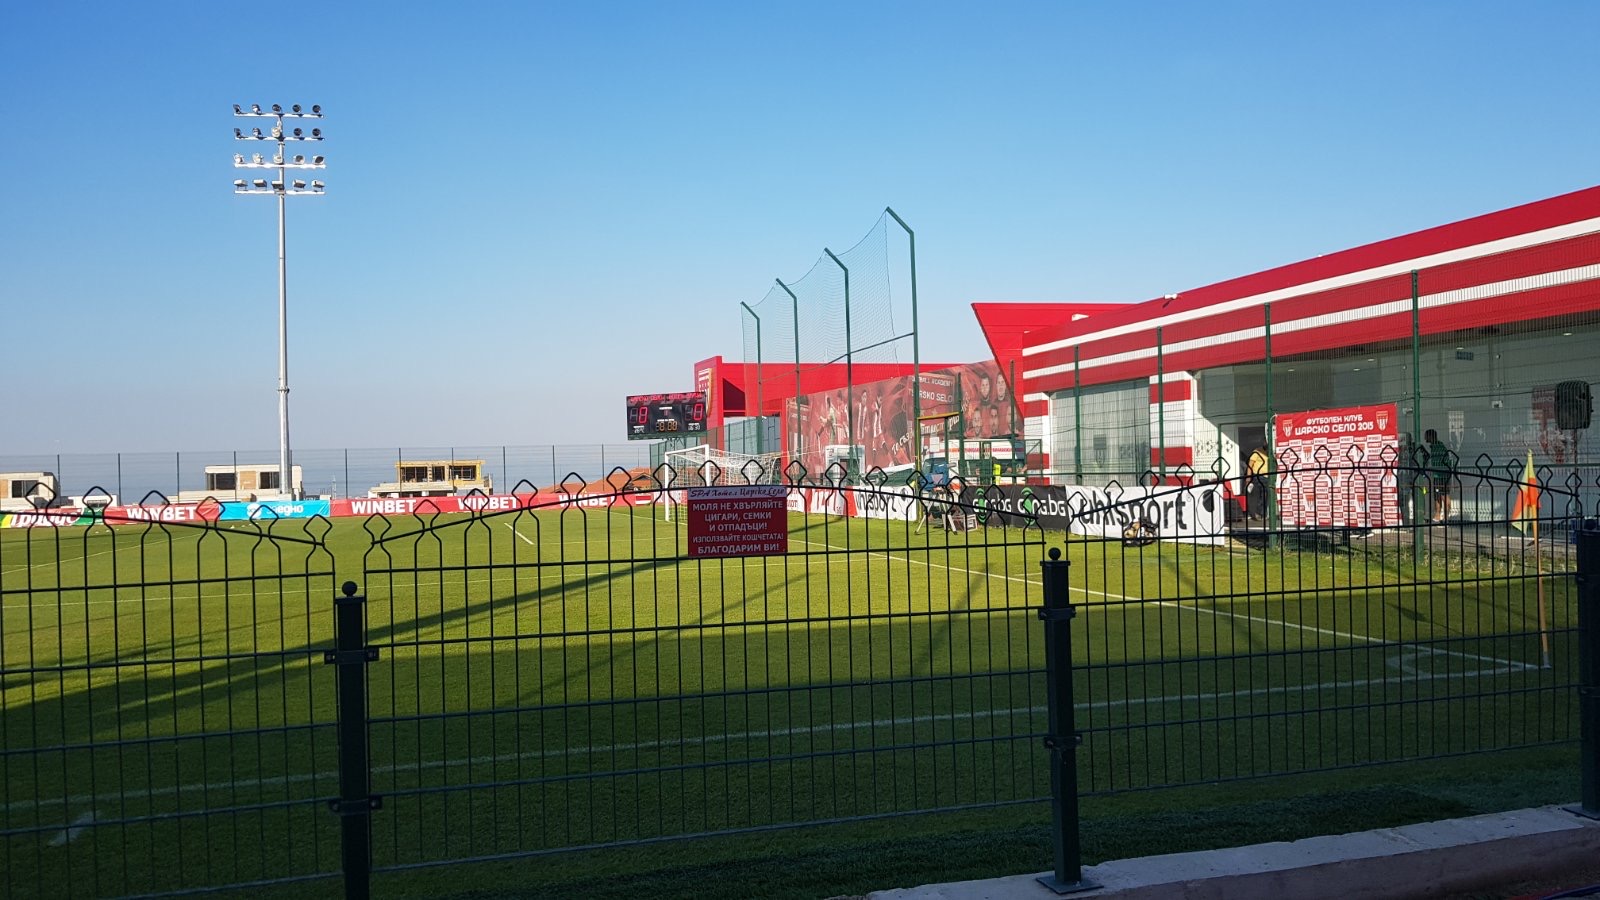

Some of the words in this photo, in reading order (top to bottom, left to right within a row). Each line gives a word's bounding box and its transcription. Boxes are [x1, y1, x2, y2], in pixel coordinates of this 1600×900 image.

[1306, 415, 1342, 425] ФУТБОЛЕН
[1344, 414, 1363, 422] КЛУБ
[1295, 424, 1329, 436] ЦАРСКО
[1332, 423, 1356, 433] СЕЛО
[1357, 421, 1374, 431] 2015
[690, 489, 710, 498] SPA
[351, 499, 417, 514] WINBET
[458, 497, 518, 510] WINBET
[692, 503, 718, 511] МОЛЯ
[720, 502, 731, 510] НЕ
[733, 500, 783, 510] ХВЪРЛЯЙТЕ
[127, 506, 197, 521] WINBET
[1080, 490, 1187, 530] uhlsport
[704, 513, 740, 522] ЦИГАРИ,
[743, 511, 771, 520] СЕМКИ
[709, 524, 715, 532] И
[718, 522, 767, 532] ОТПАДЪЦИ!
[692, 534, 740, 543] ИЗПОЛЗВАЙТЕ
[742, 533, 783, 541] КОШЧЕТАТА!
[698, 544, 761, 554] БЛАГОДАРИМ
[764, 543, 779, 551] ВИ!
